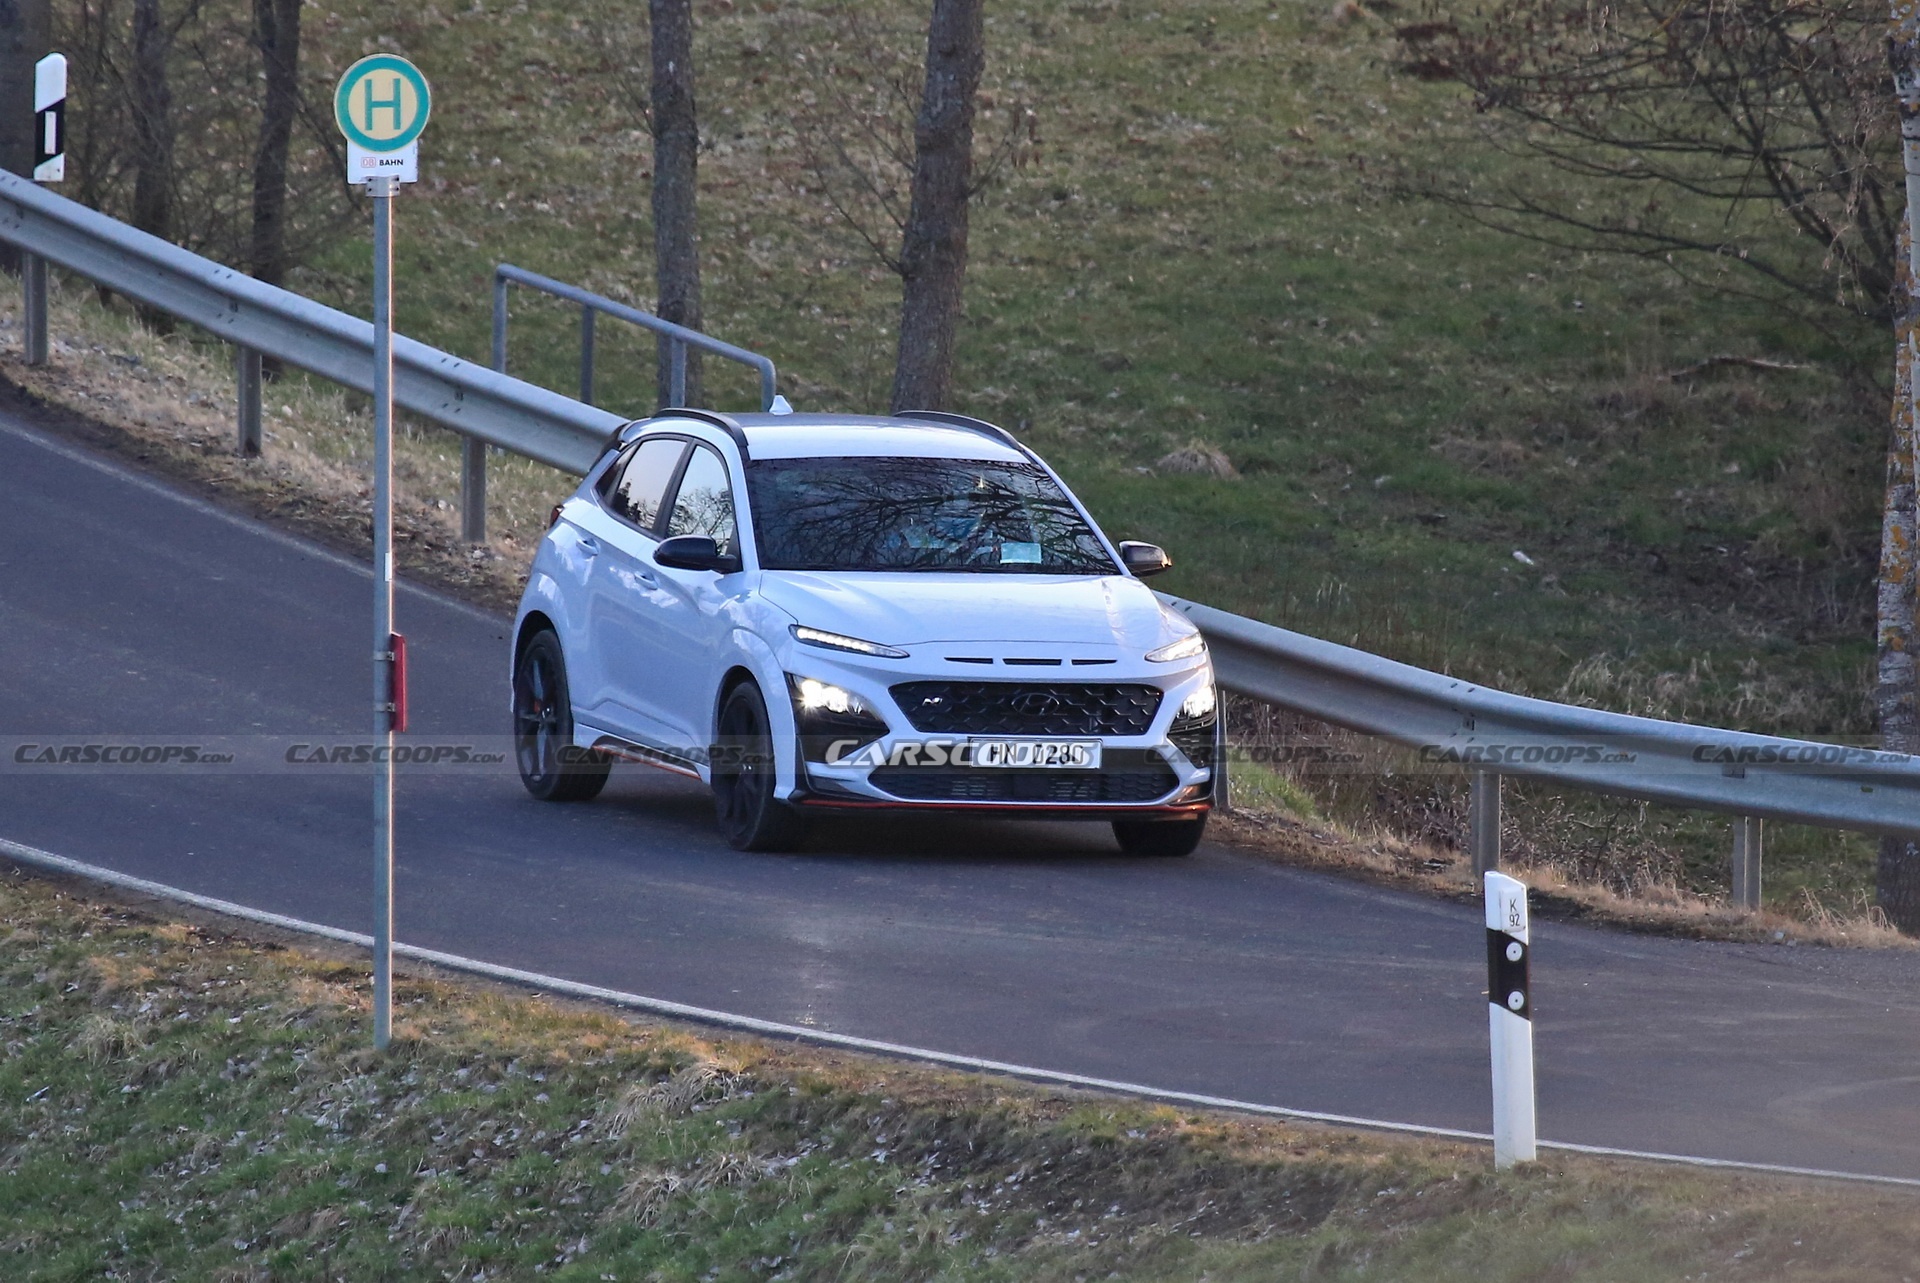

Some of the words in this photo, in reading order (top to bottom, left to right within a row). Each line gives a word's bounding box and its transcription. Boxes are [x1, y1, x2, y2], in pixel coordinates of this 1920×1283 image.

[364, 78, 402, 131] H
[1509, 899, 1517, 913] K
[1509, 913, 1520, 927] 92
